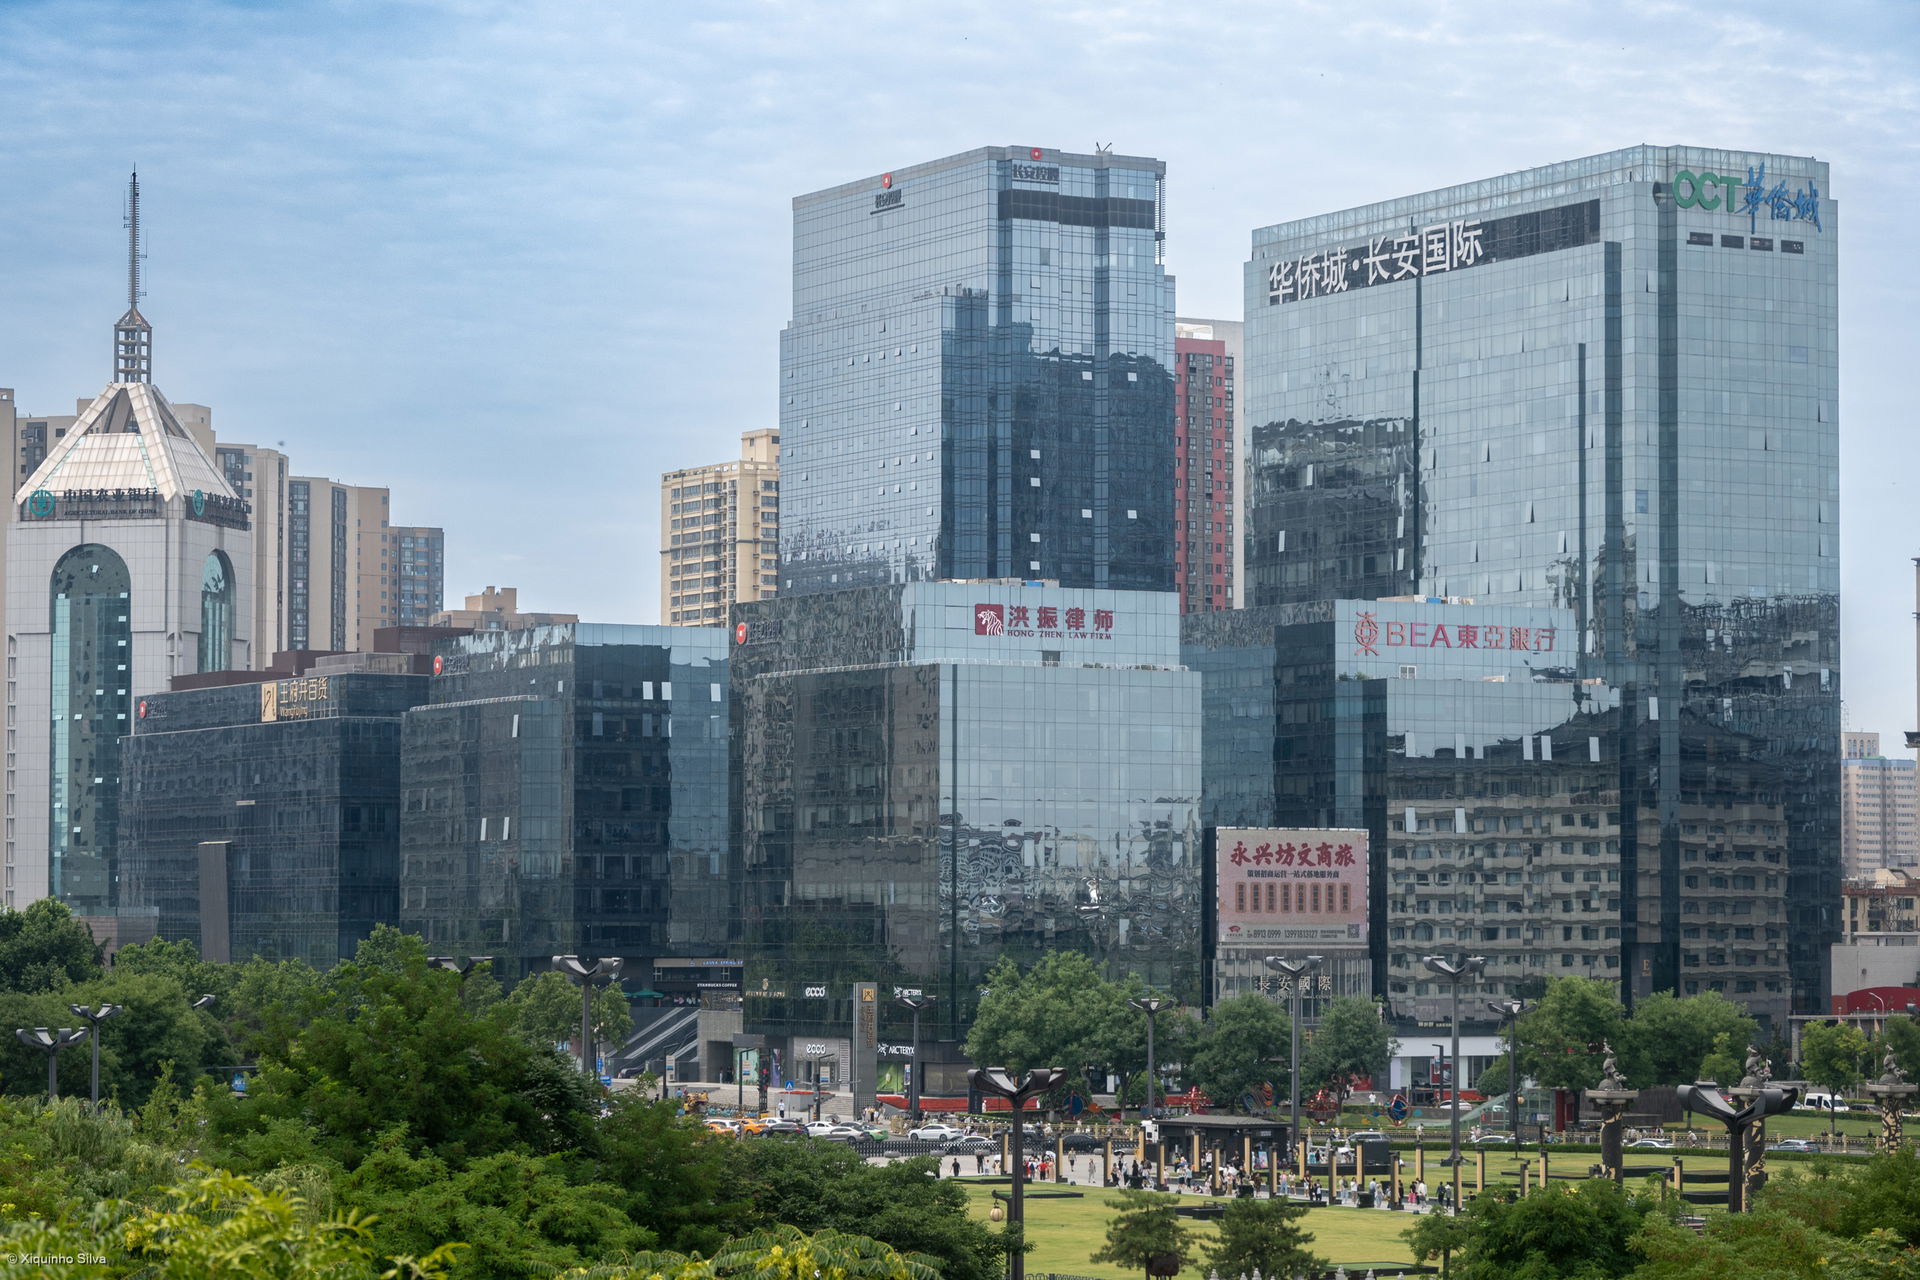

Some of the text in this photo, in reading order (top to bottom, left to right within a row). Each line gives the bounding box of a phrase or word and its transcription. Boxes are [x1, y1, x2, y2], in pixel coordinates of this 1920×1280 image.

[1672, 169, 1743, 213] OCT
[1268, 218, 1483, 305] 华侨城·长安国际
[63, 487, 157, 503] 中国农业银行
[1007, 604, 1114, 632] 洪振律师
[1007, 629, 1112, 641] HONG ZHEN LAW FIRM
[1386, 621, 1453, 649] BEA
[279, 676, 329, 704] 王府井百货
[1230, 840, 1356, 867] 永兴坊文商旅
[805, 986, 826, 997] ecco
[1258, 975, 1331, 991] 長安國際
[806, 1043, 826, 1054] ecco
